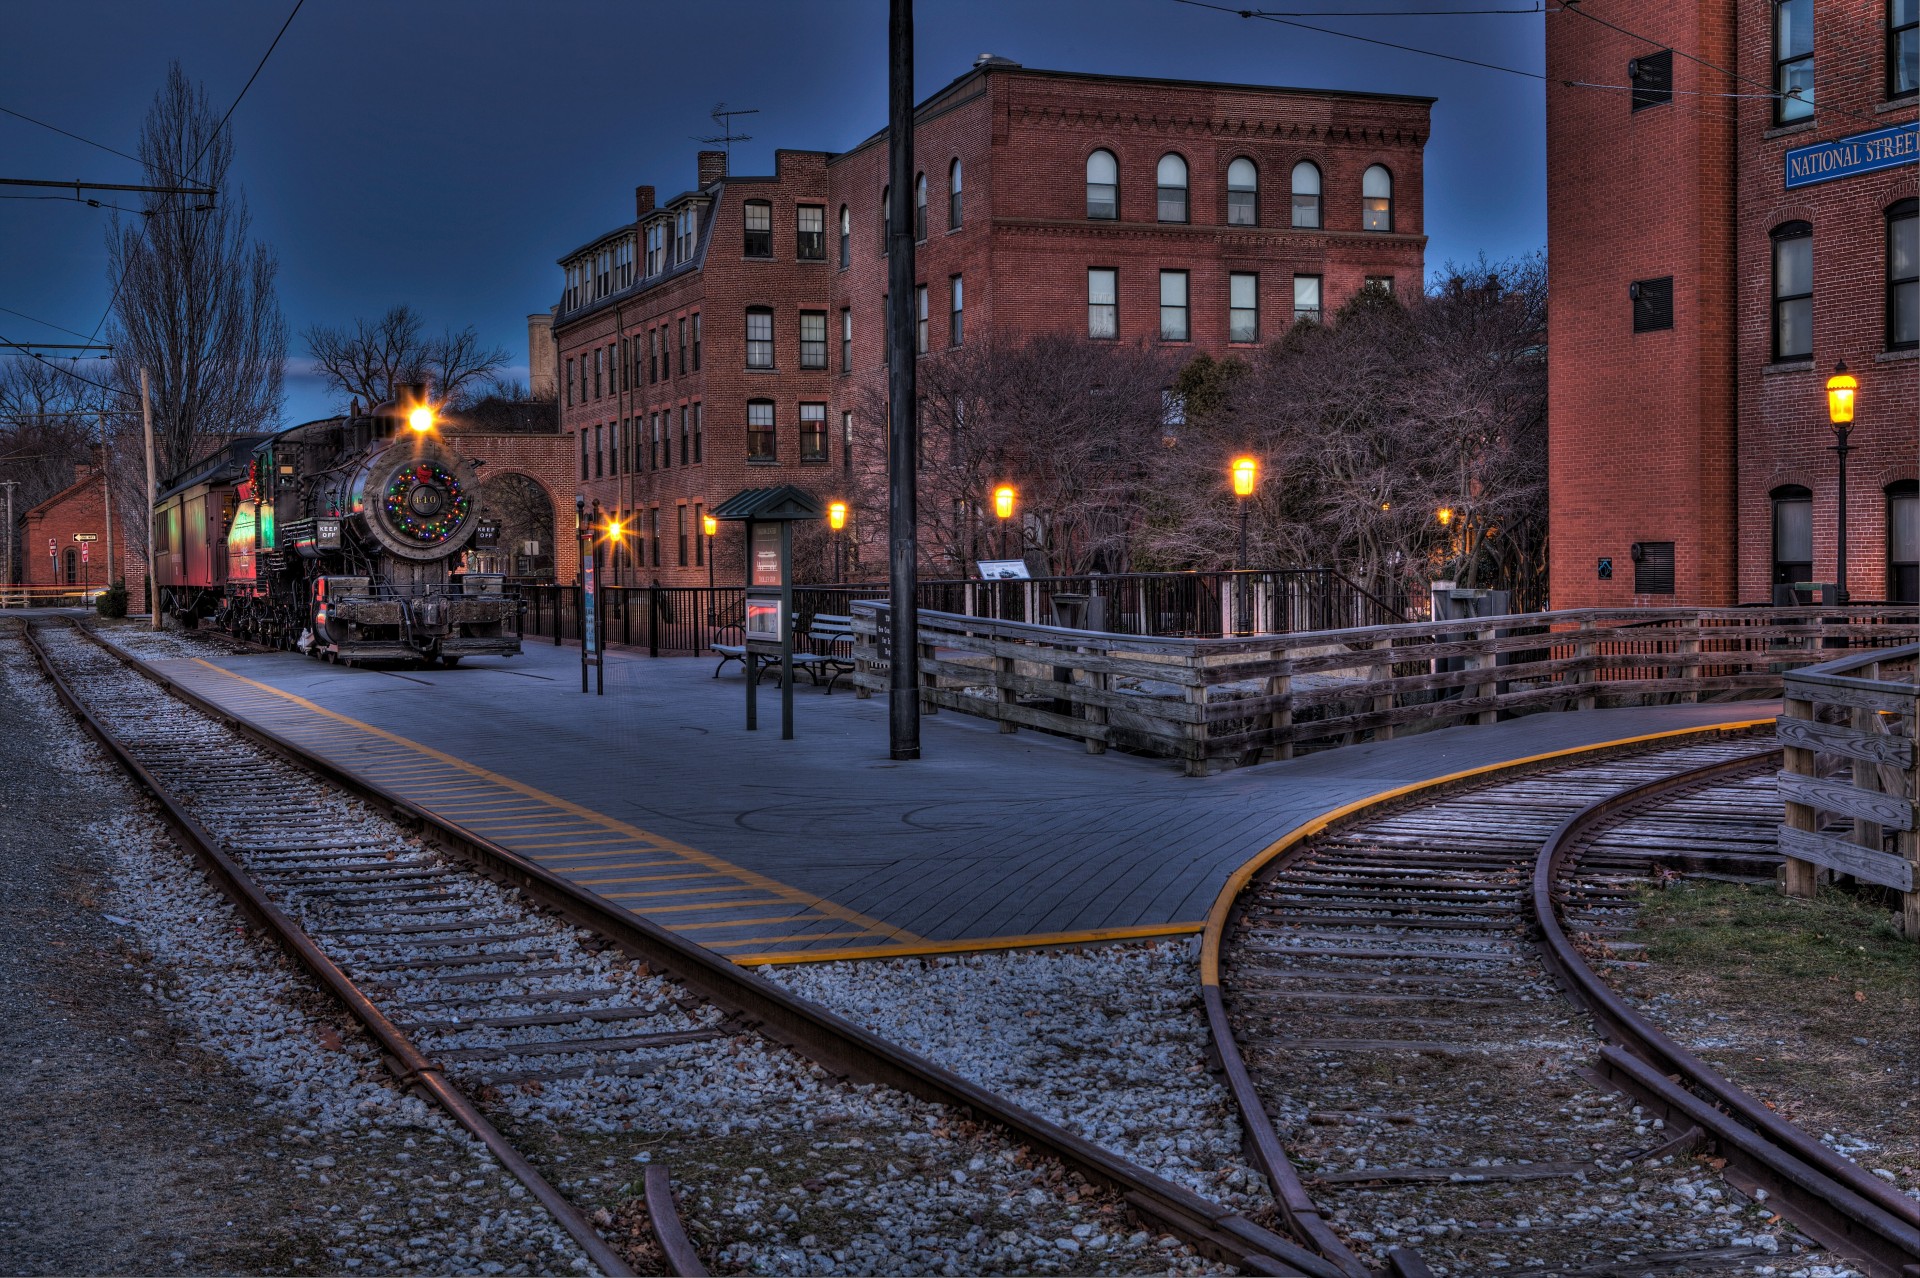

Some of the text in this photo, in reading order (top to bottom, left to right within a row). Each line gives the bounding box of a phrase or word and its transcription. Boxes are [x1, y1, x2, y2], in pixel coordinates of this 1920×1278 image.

[1790, 131, 1919, 178] NATIONAL STREET
[414, 496, 436, 504] 410
